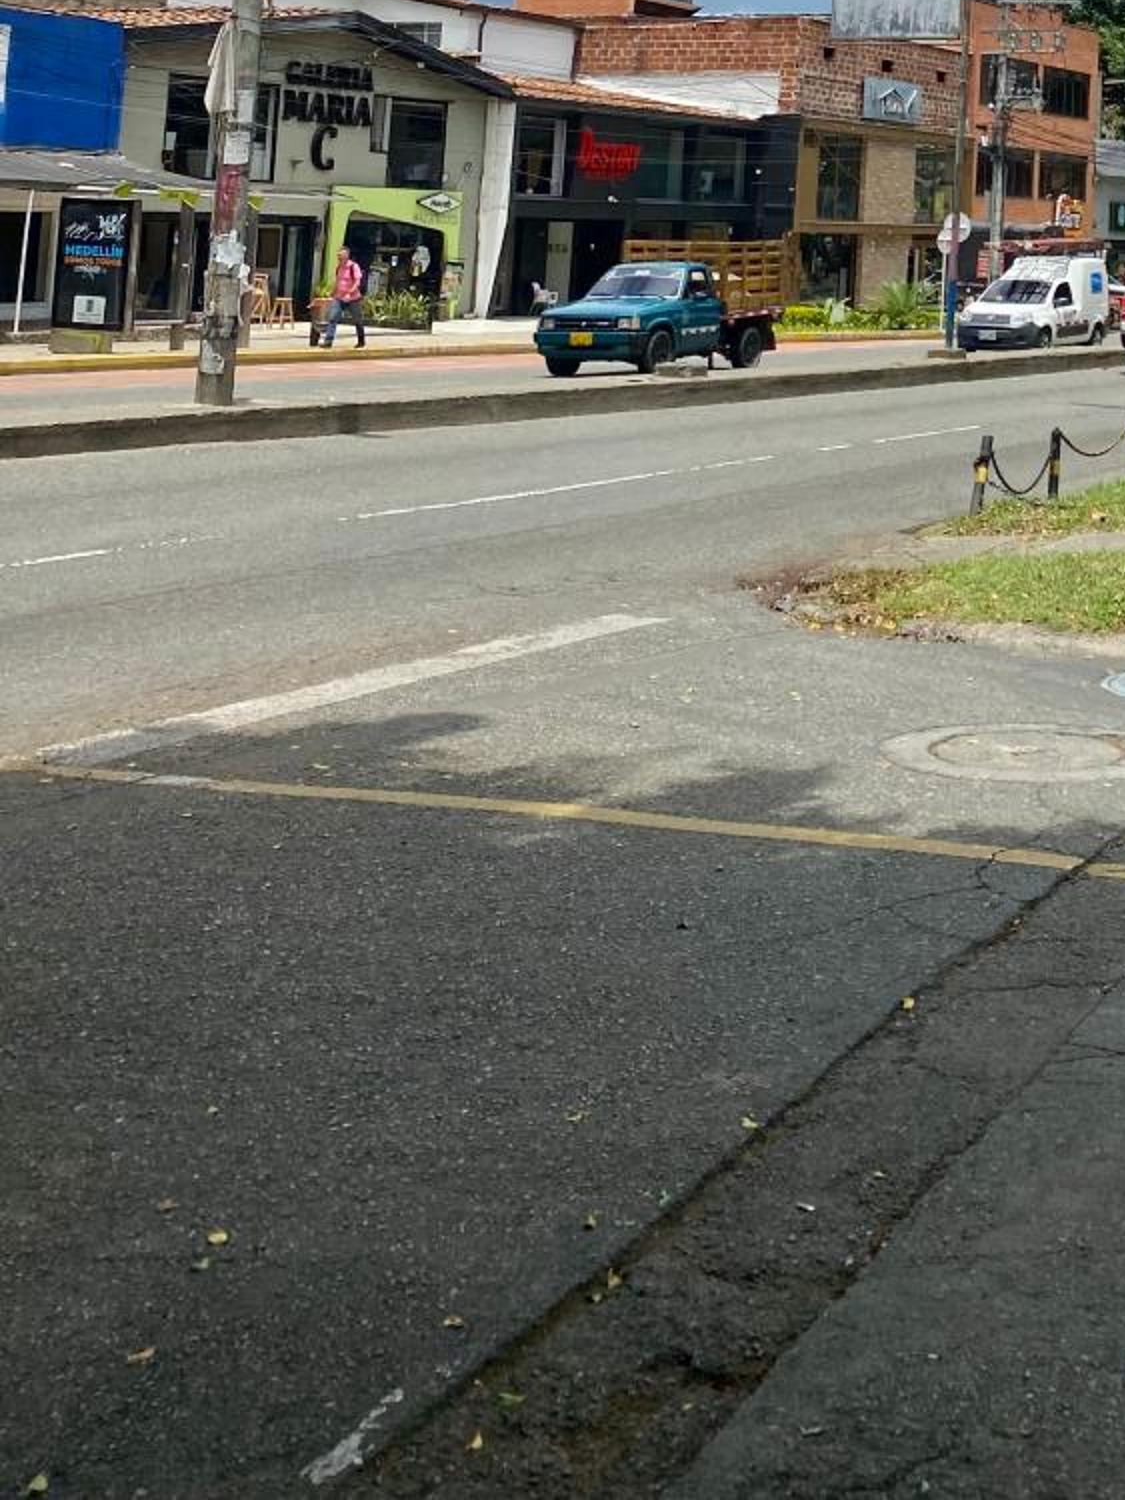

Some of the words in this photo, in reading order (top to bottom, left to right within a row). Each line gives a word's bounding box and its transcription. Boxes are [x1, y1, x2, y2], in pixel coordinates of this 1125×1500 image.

[282, 89, 372, 127] MARIA
[310, 125, 339, 172] C
[64, 243, 124, 258] MEDELLÍN
